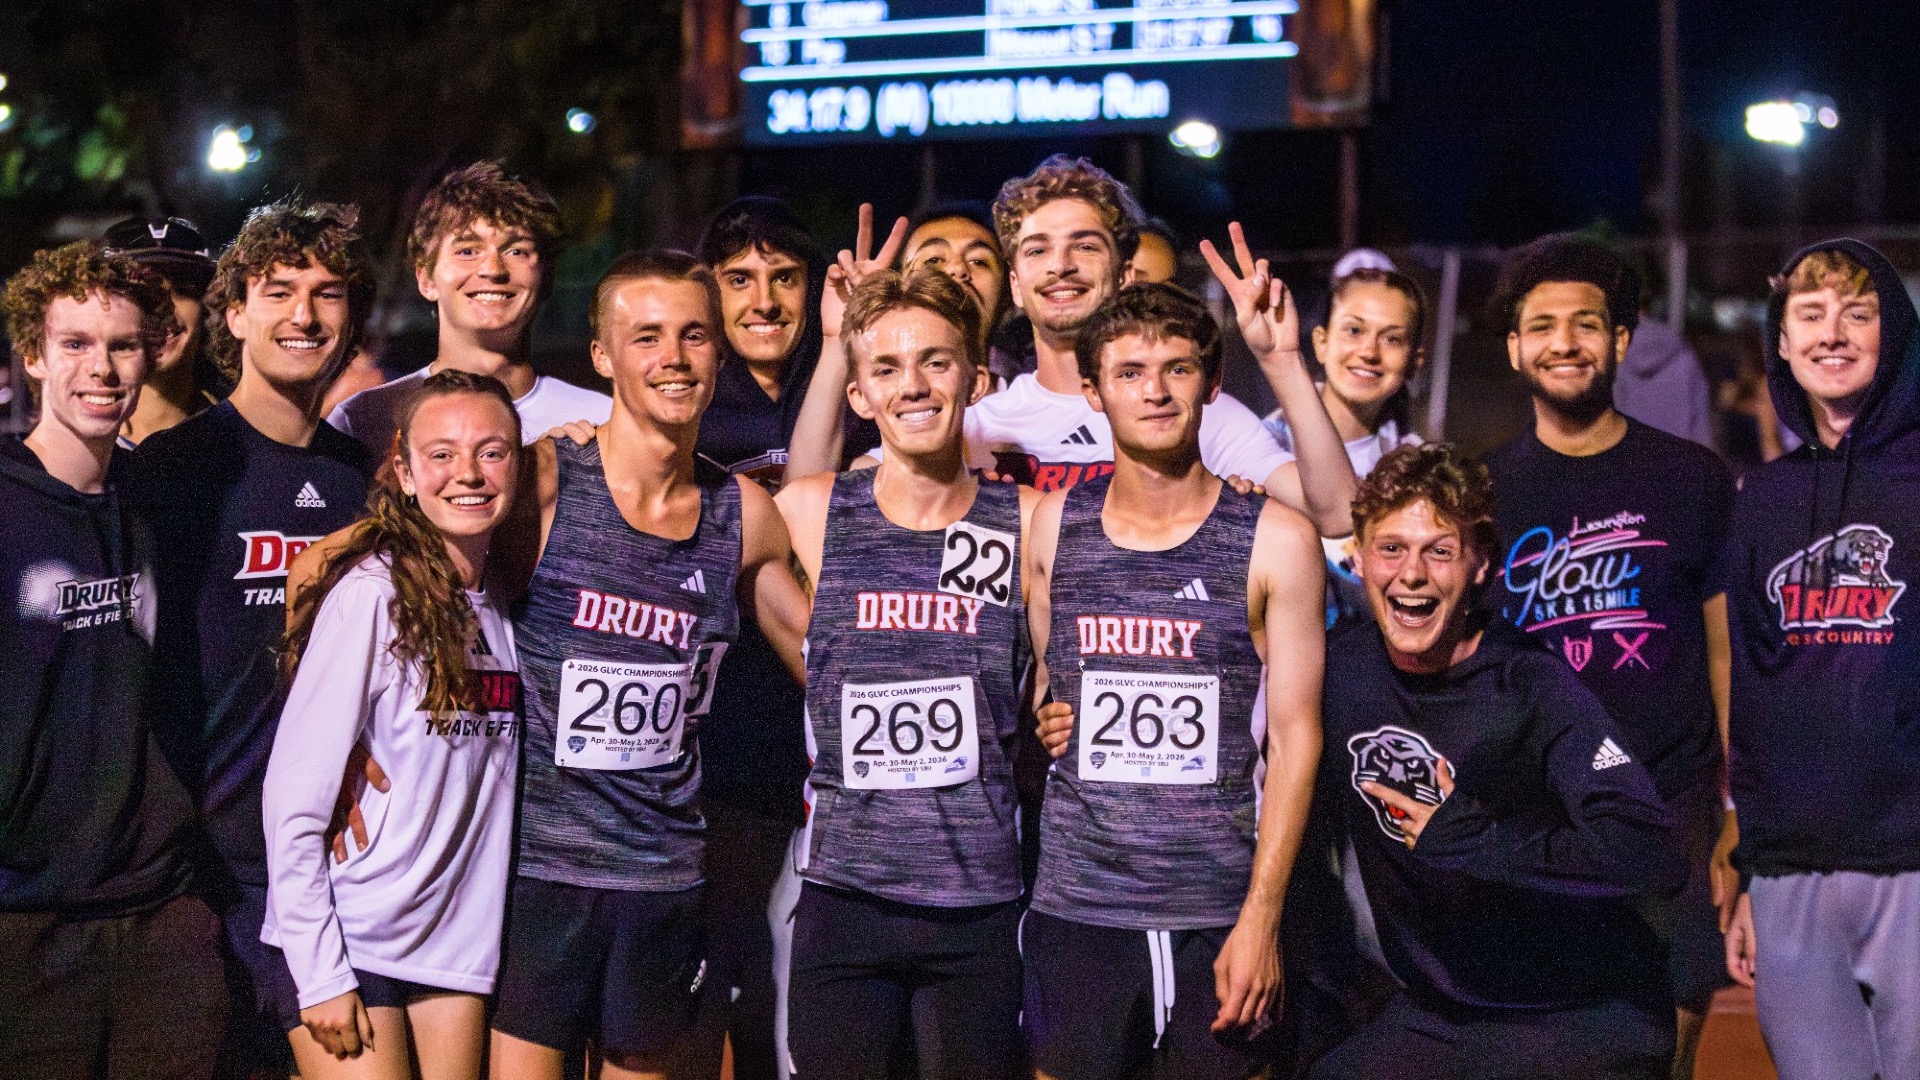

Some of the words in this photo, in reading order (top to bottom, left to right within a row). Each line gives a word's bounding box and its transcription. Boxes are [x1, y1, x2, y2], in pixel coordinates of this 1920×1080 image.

[1016, 75, 1101, 123] Meter
[1102, 71, 1170, 120] Run
[295, 497, 326, 508] adidas
[939, 530, 1012, 602] 22
[1504, 526, 1642, 627] Glow
[244, 588, 286, 605] TRA
[855, 591, 985, 635] DRURY
[1565, 597, 1576, 615] &
[94, 614, 102, 625] &
[572, 589, 698, 650] DRURY
[1077, 614, 1203, 659] DRURY
[1814, 630, 1895, 645] COUNTRY
[577, 664, 599, 673] 2026
[600, 666, 622, 676] GLVC
[850, 689, 866, 699] 2026
[867, 689, 889, 699] GLVC
[891, 683, 962, 697] CHAMPIONSHIPS
[1094, 678, 1113, 686] 2026
[1114, 679, 1136, 687] GLVC
[1137, 680, 1208, 690] CHAMPIONSHIPS
[569, 678, 682, 736] 260
[485, 720, 496, 737] &
[850, 698, 964, 756] 269
[1090, 691, 1206, 750] 263
[590, 736, 607, 745] Apr.
[608, 738, 635, 746] 30-May
[873, 759, 888, 768] Apr.
[889, 758, 918, 767] 30-May
[928, 756, 947, 764] 2026
[1110, 751, 1125, 759] Apr.
[1126, 752, 1155, 760] 30-May
[1592, 754, 1631, 770] adidas
